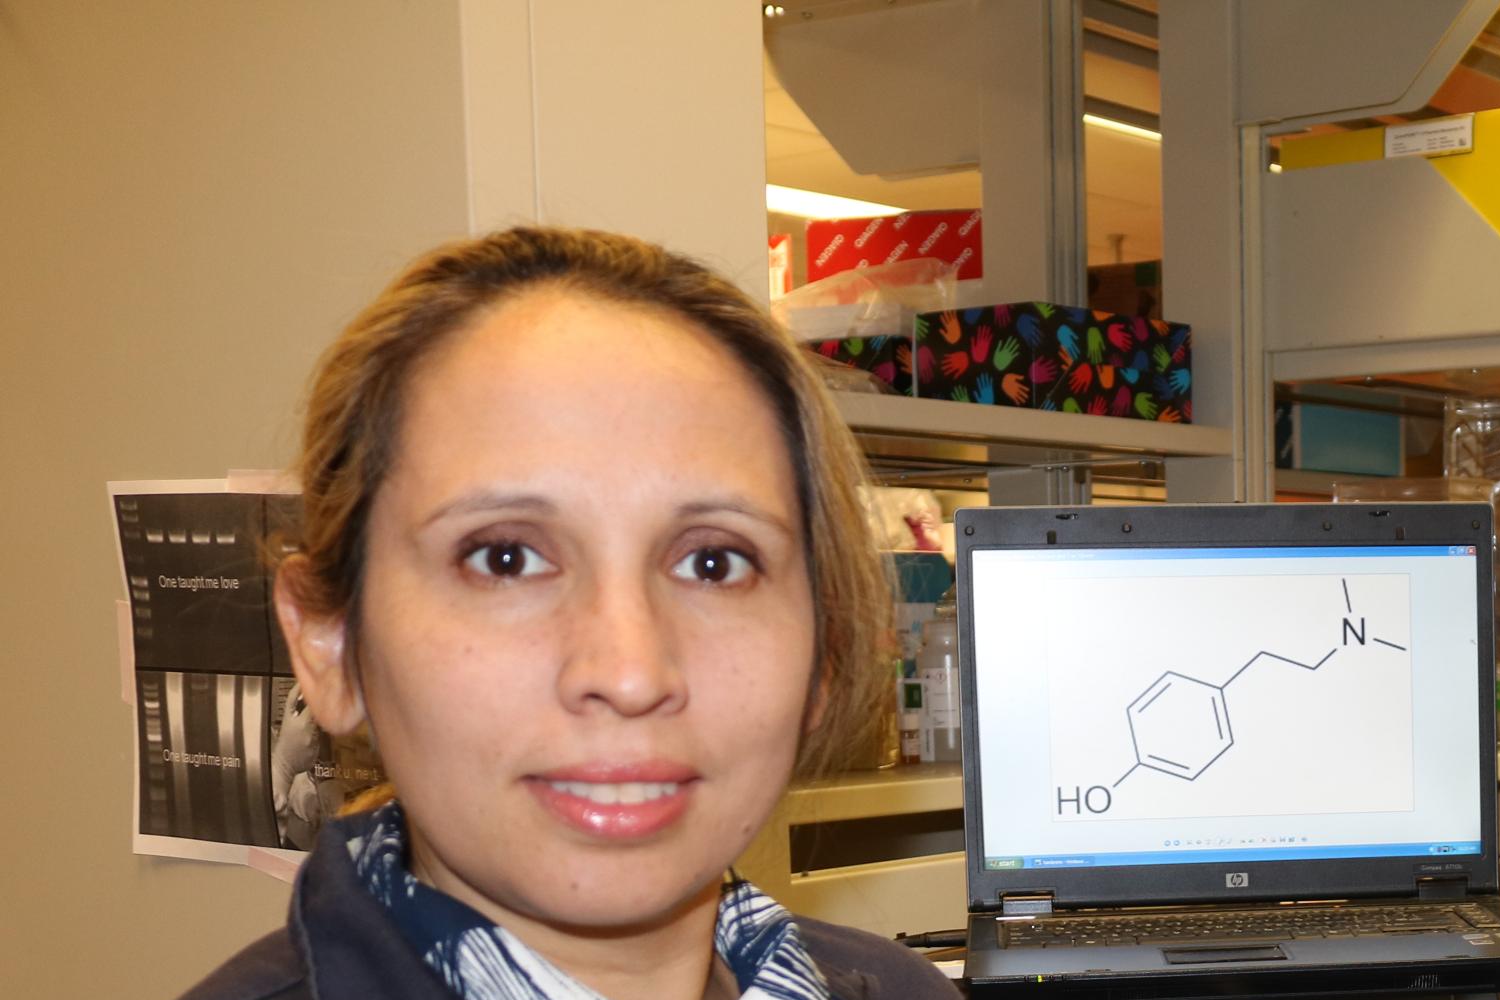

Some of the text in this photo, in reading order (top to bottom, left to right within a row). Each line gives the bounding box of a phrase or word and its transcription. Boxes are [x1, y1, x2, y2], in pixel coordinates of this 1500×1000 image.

[815, 234, 845, 267] QIAGEN
[158, 574, 240, 592] One taught me love
[1342, 617, 1366, 646] N
[163, 748, 180, 763] One
[207, 754, 221, 767] me
[222, 756, 241, 770] pain
[1057, 785, 1112, 815] HO
